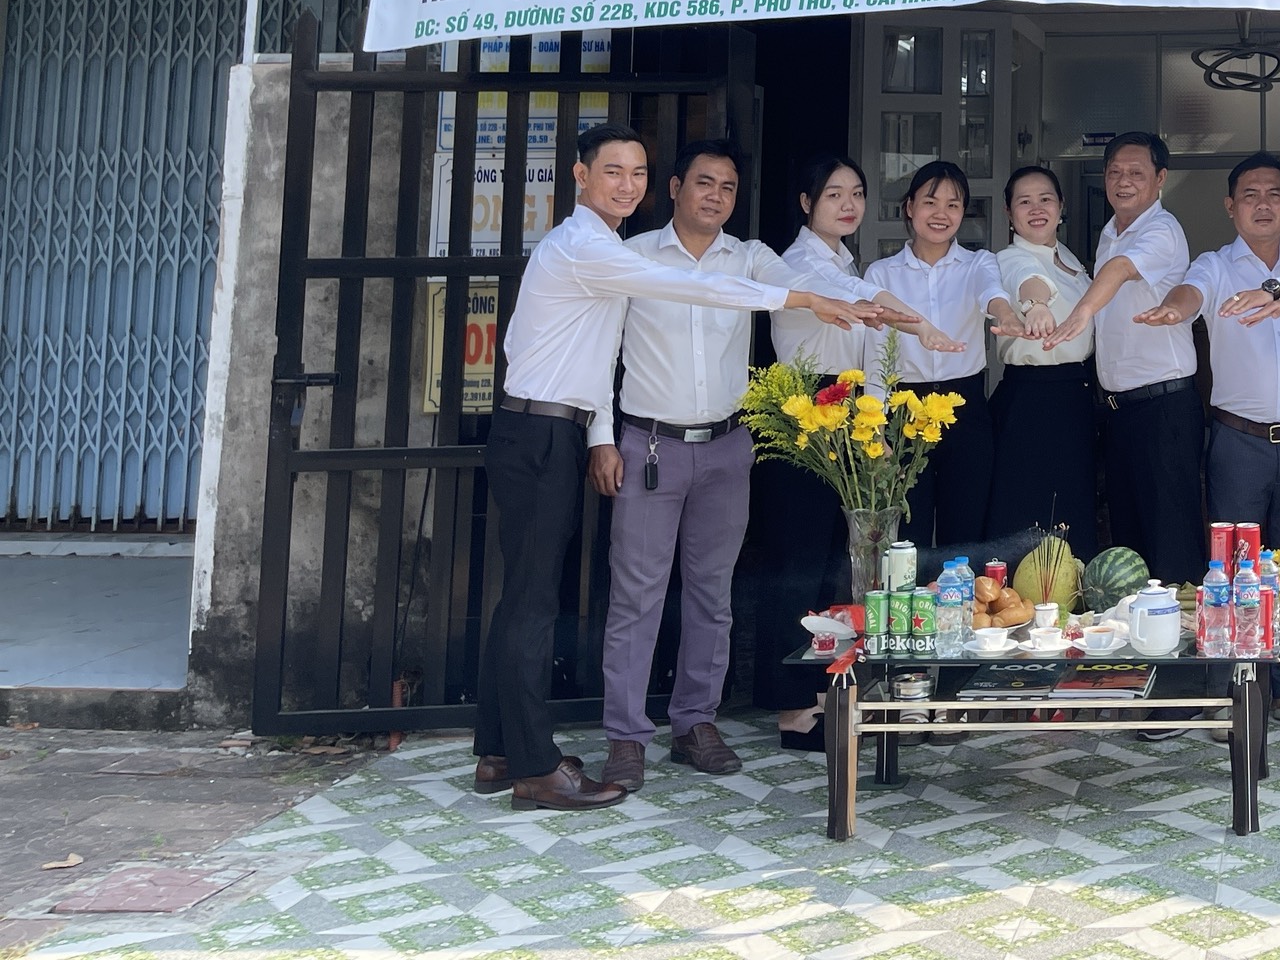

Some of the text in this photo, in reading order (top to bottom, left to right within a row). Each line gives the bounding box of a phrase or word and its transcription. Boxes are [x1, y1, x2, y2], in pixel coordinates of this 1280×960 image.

[414, 19, 441, 39] ĐC:
[444, 11, 470, 34] SỐ
[472, 11, 499, 32] 49,
[503, 1, 566, 29] ĐƯỜNG
[598, 1, 639, 23] 22B,
[643, 0, 682, 19] KDC
